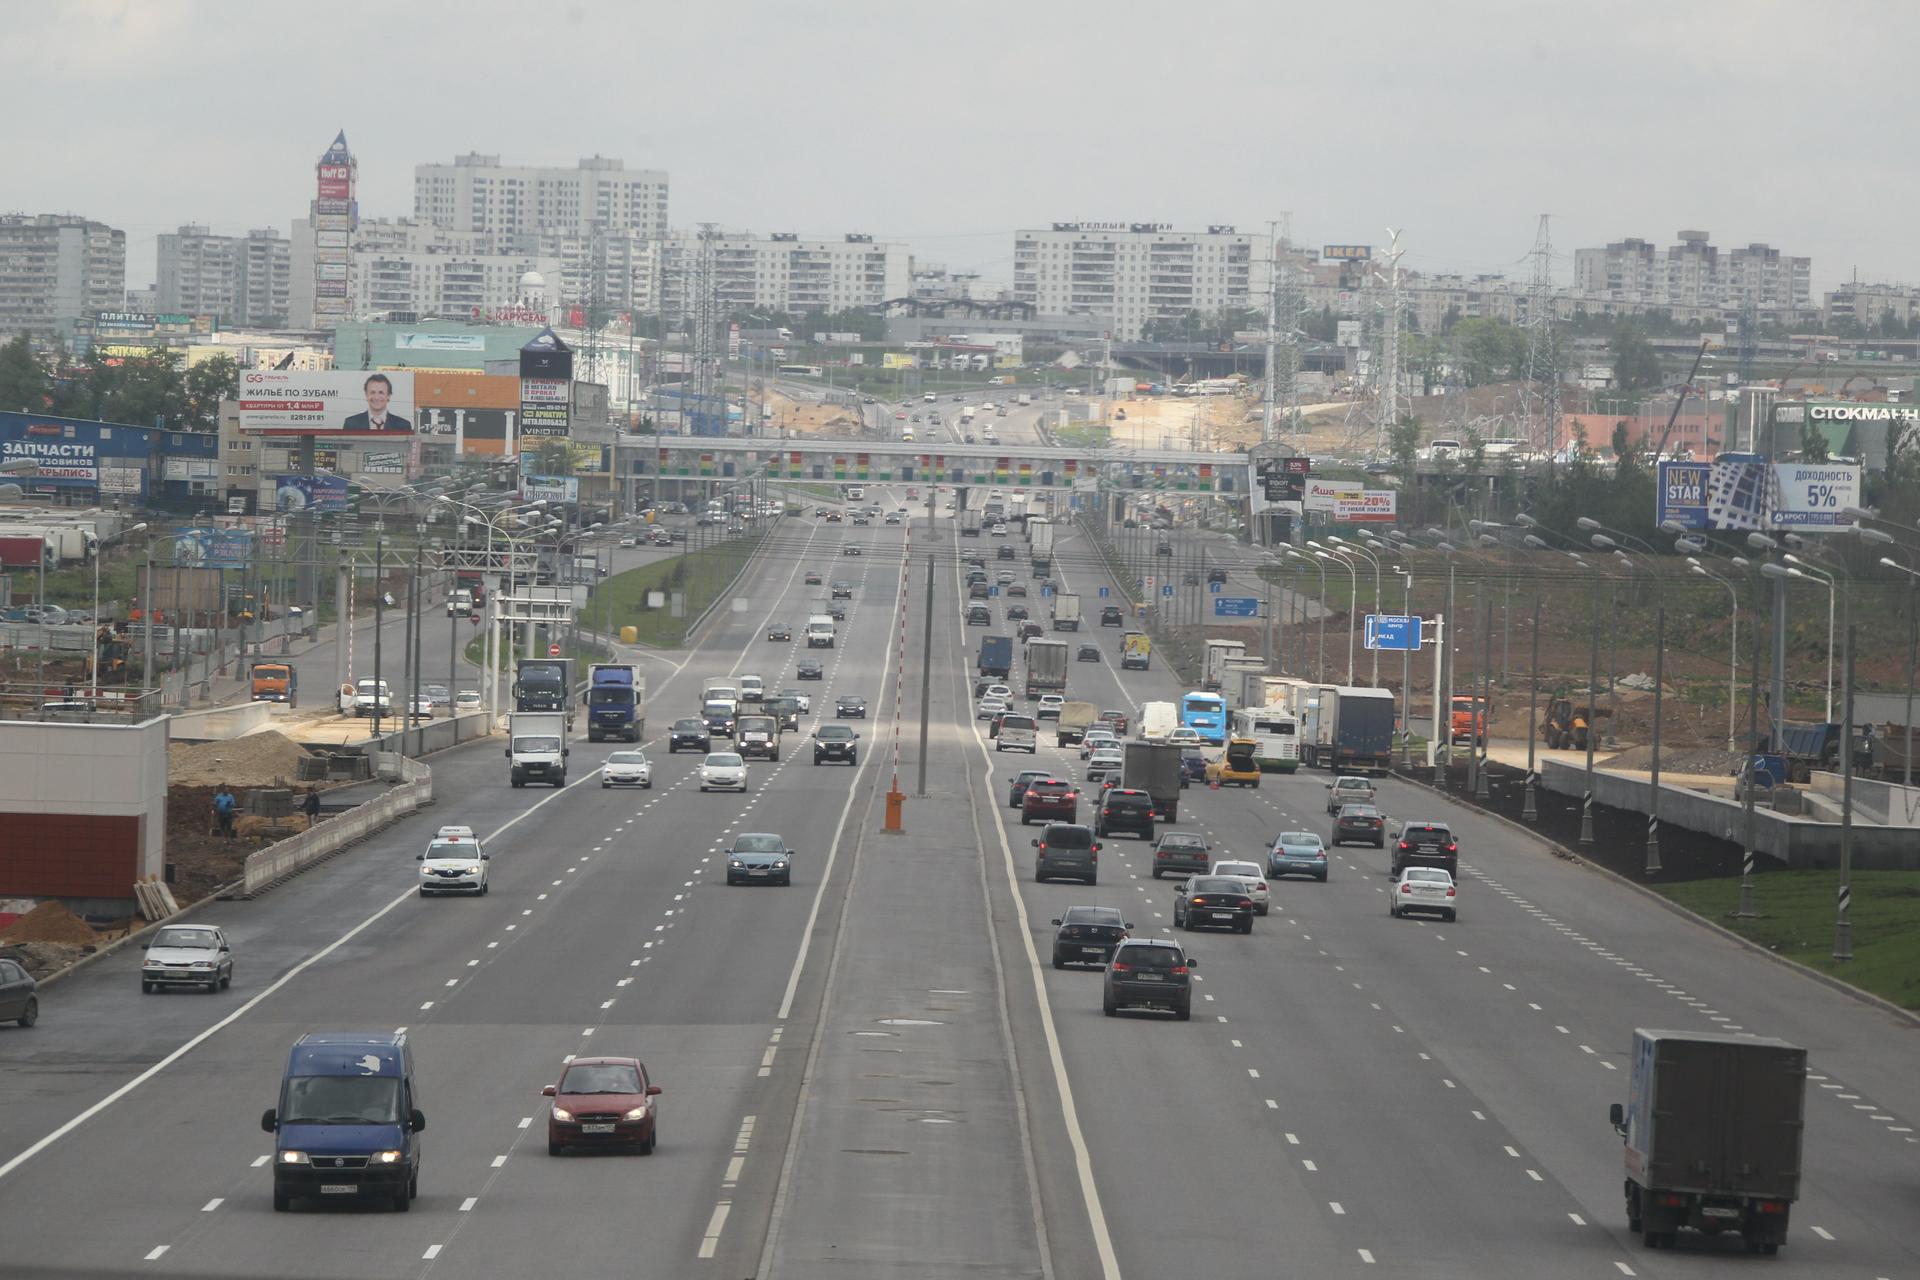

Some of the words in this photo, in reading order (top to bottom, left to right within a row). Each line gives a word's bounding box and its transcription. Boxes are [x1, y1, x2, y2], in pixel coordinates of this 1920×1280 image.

[1325, 247, 1367, 257] IKEA
[101, 312, 145, 321] ПЛИТКА
[495, 312, 547, 322] КАРУСЕЛЬ
[246, 387, 282, 397] ЖИЛЬЁ
[285, 389, 300, 397] ПО
[302, 389, 339, 398] ЗУБАМ!
[286, 402, 300, 410] 1,4
[1810, 406, 1919, 420] СТОКМАНН
[2, 442, 95, 457] ЗАПЧАСТИ
[1669, 469, 1701, 485] NEW
[1795, 470, 1853, 482] ДОХОДНОСТЬ
[1668, 485, 1700, 500] STAR
[1807, 485, 1837, 507] 5%
